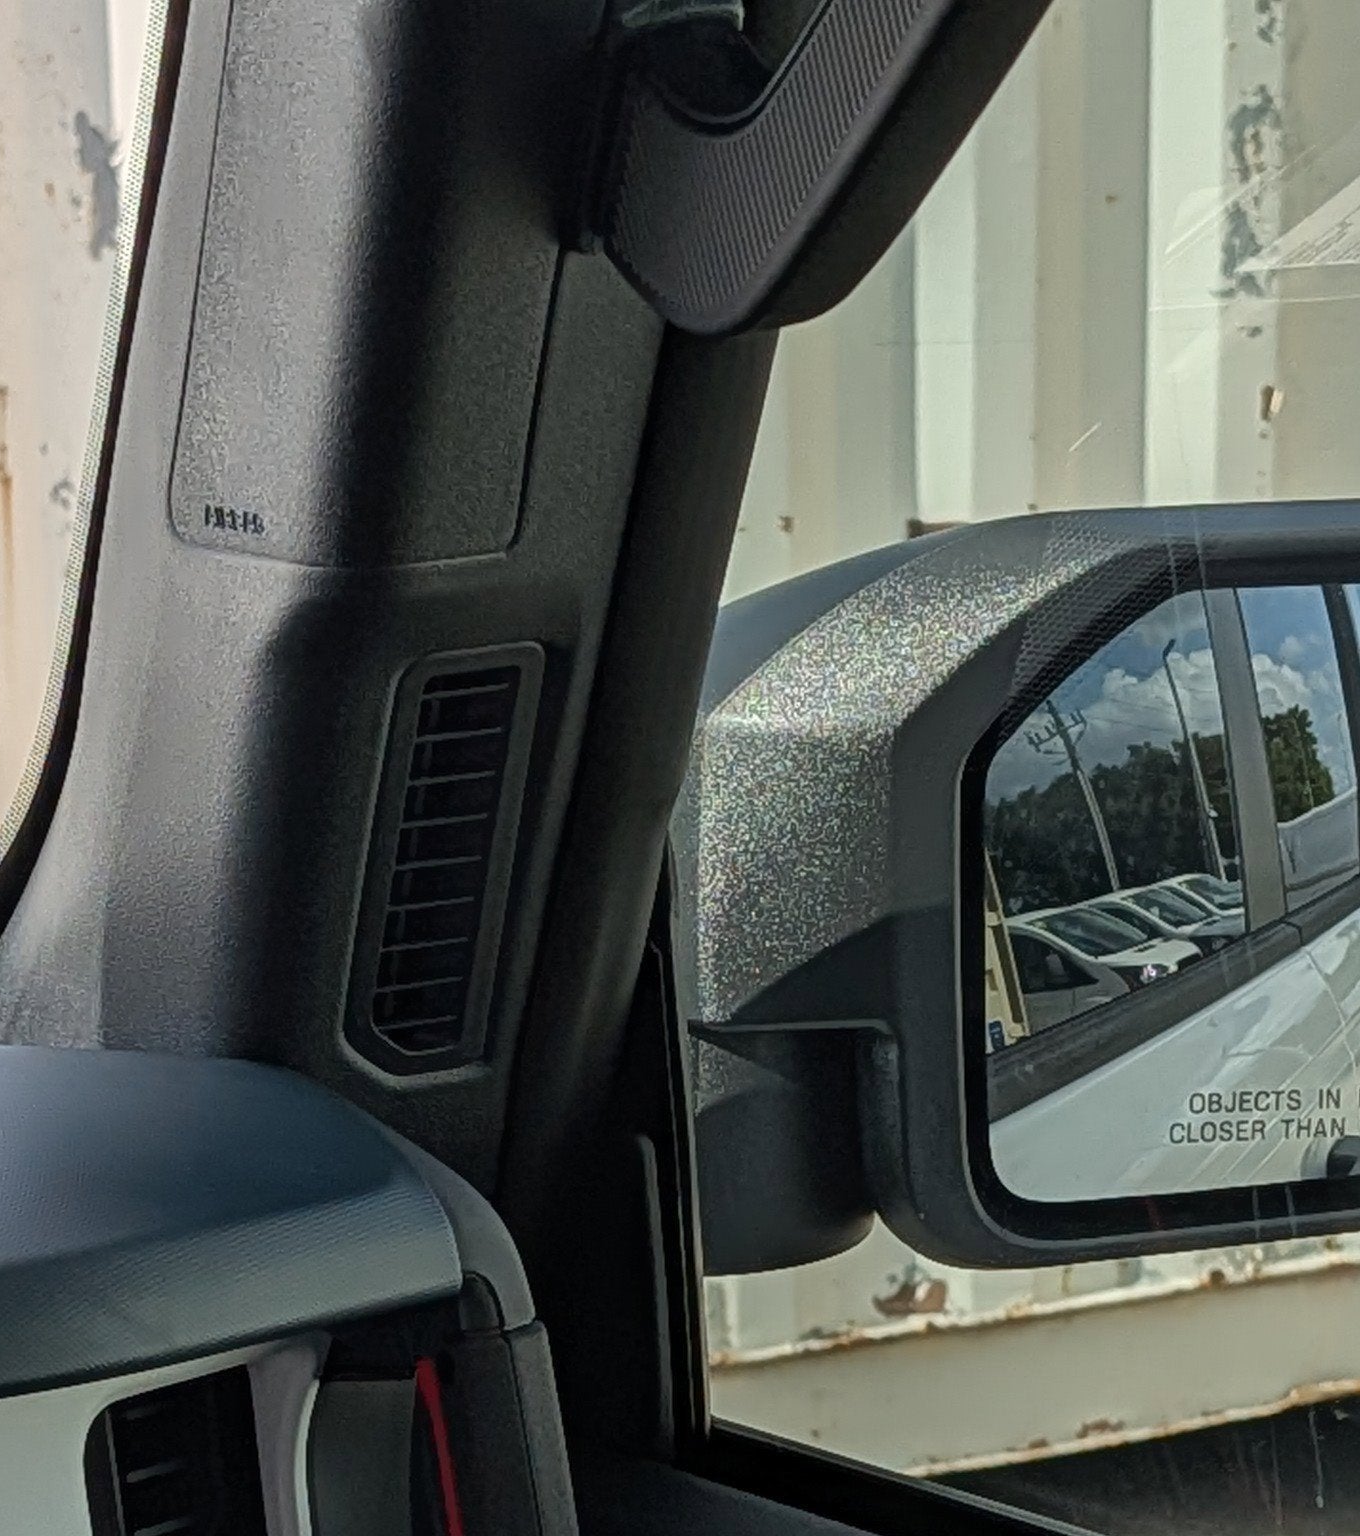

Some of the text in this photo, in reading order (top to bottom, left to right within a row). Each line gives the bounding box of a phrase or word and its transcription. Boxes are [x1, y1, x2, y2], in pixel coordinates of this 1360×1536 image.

[1189, 1091, 1301, 1114] OBJECTS
[1318, 1089, 1340, 1110] IN
[1170, 1121, 1265, 1144] CLOSER
[1281, 1118, 1346, 1139] THAN
